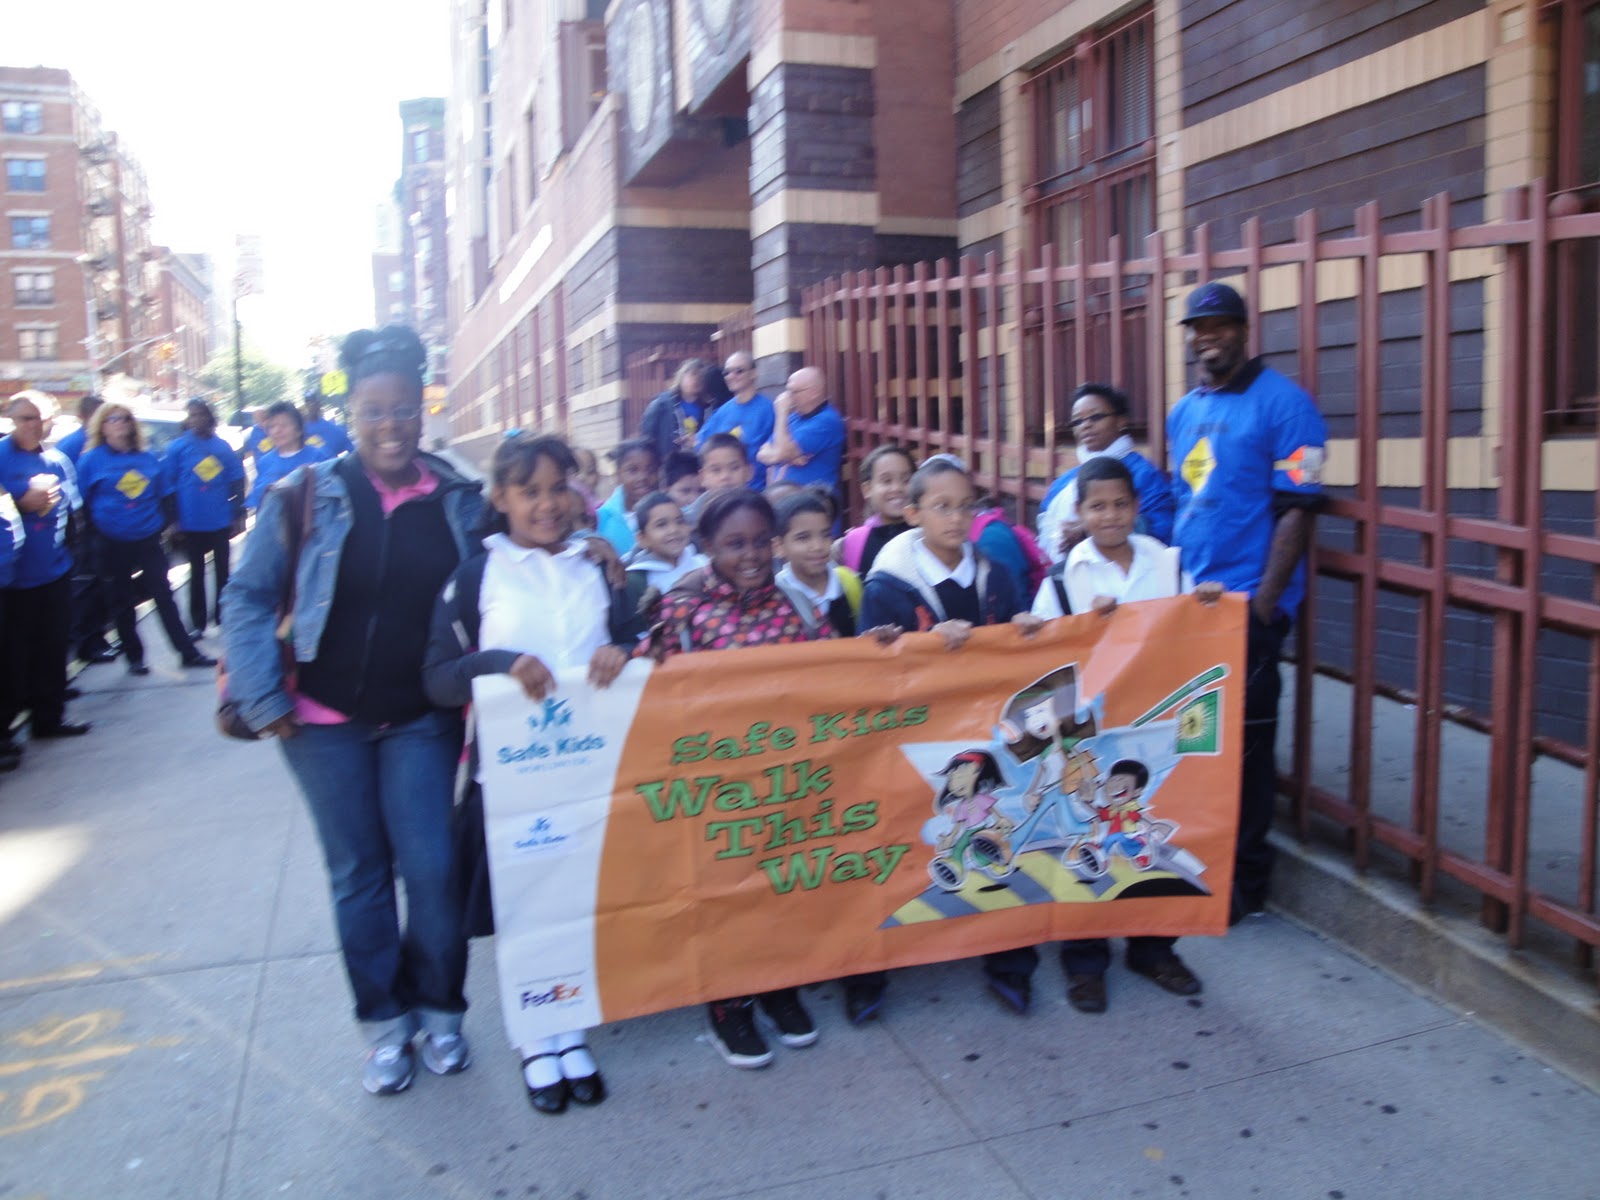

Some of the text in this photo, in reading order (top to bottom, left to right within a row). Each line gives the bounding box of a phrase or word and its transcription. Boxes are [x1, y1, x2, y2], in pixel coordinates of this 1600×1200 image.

[497, 734, 606, 764] Safe Kids
[671, 704, 930, 766] Safe Kids
[635, 759, 833, 823] Walk
[705, 798, 879, 861] This
[757, 842, 911, 896] Way
[520, 983, 584, 1011] FedEx
